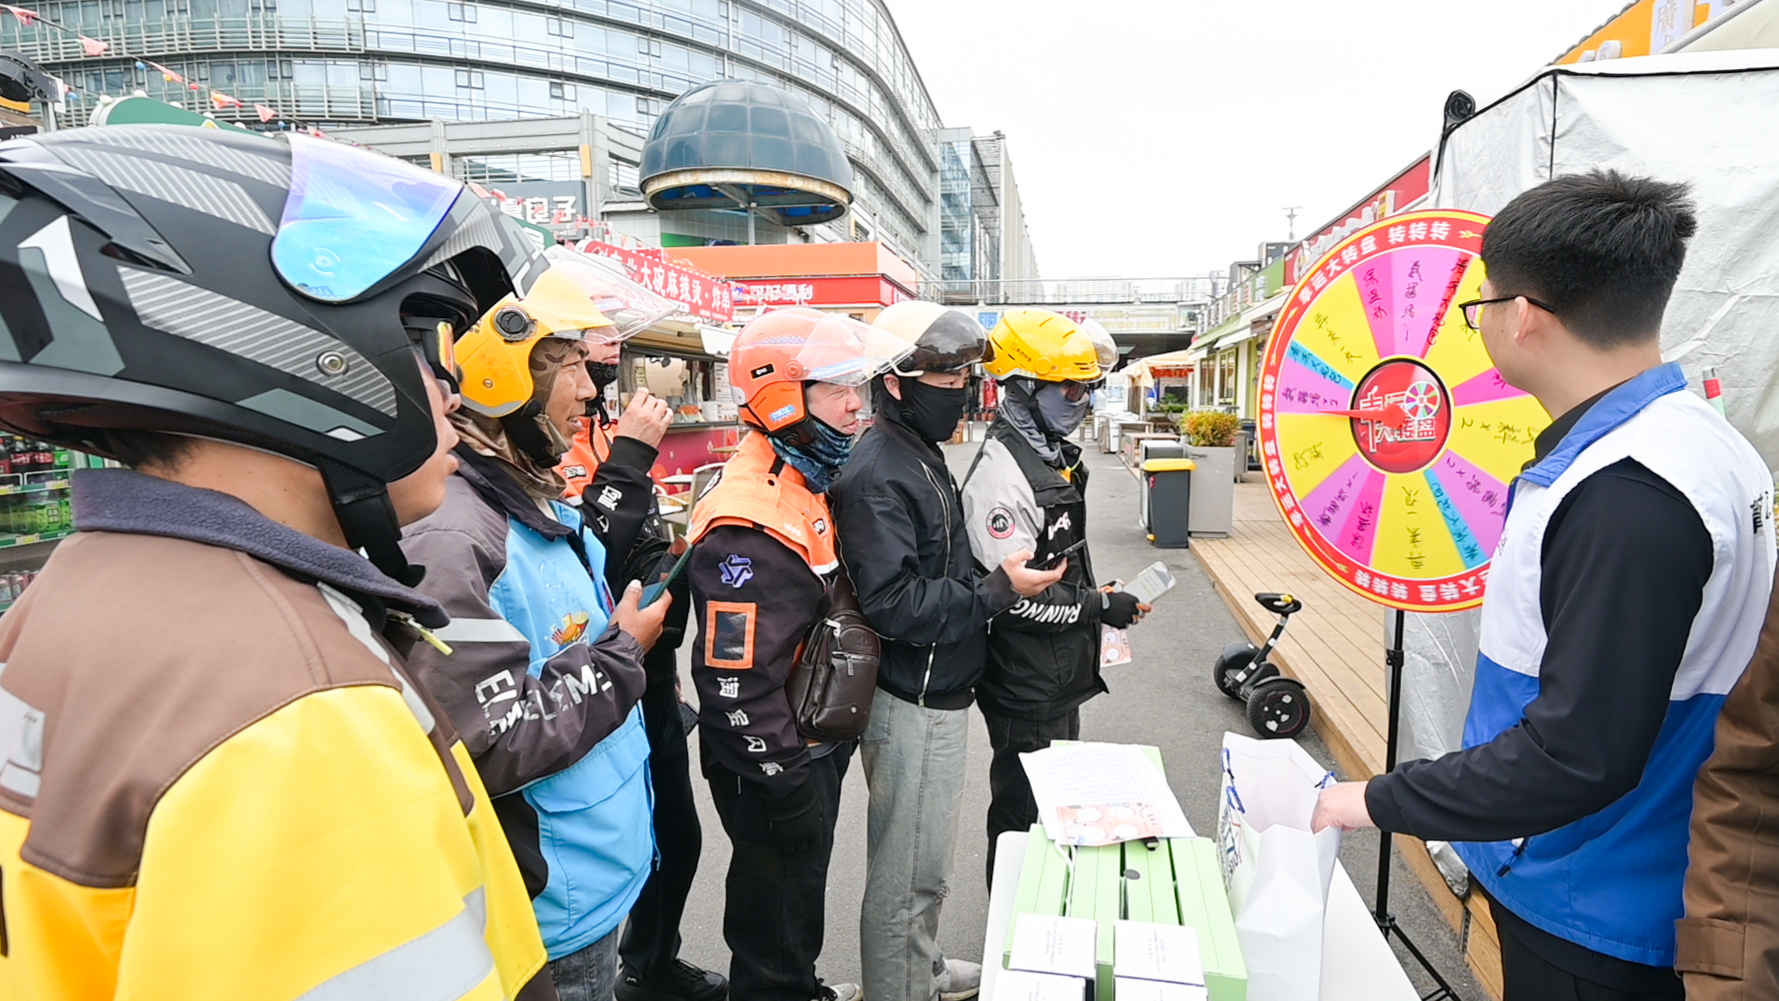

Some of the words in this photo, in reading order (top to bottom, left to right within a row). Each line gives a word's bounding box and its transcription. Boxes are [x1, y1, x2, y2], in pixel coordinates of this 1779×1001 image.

[1298, 234, 1378, 306] 幸运大转盘
[1387, 221, 1450, 245] 转转转
[1261, 373, 1276, 430] 转转转
[1354, 569, 1408, 600] 转转转
